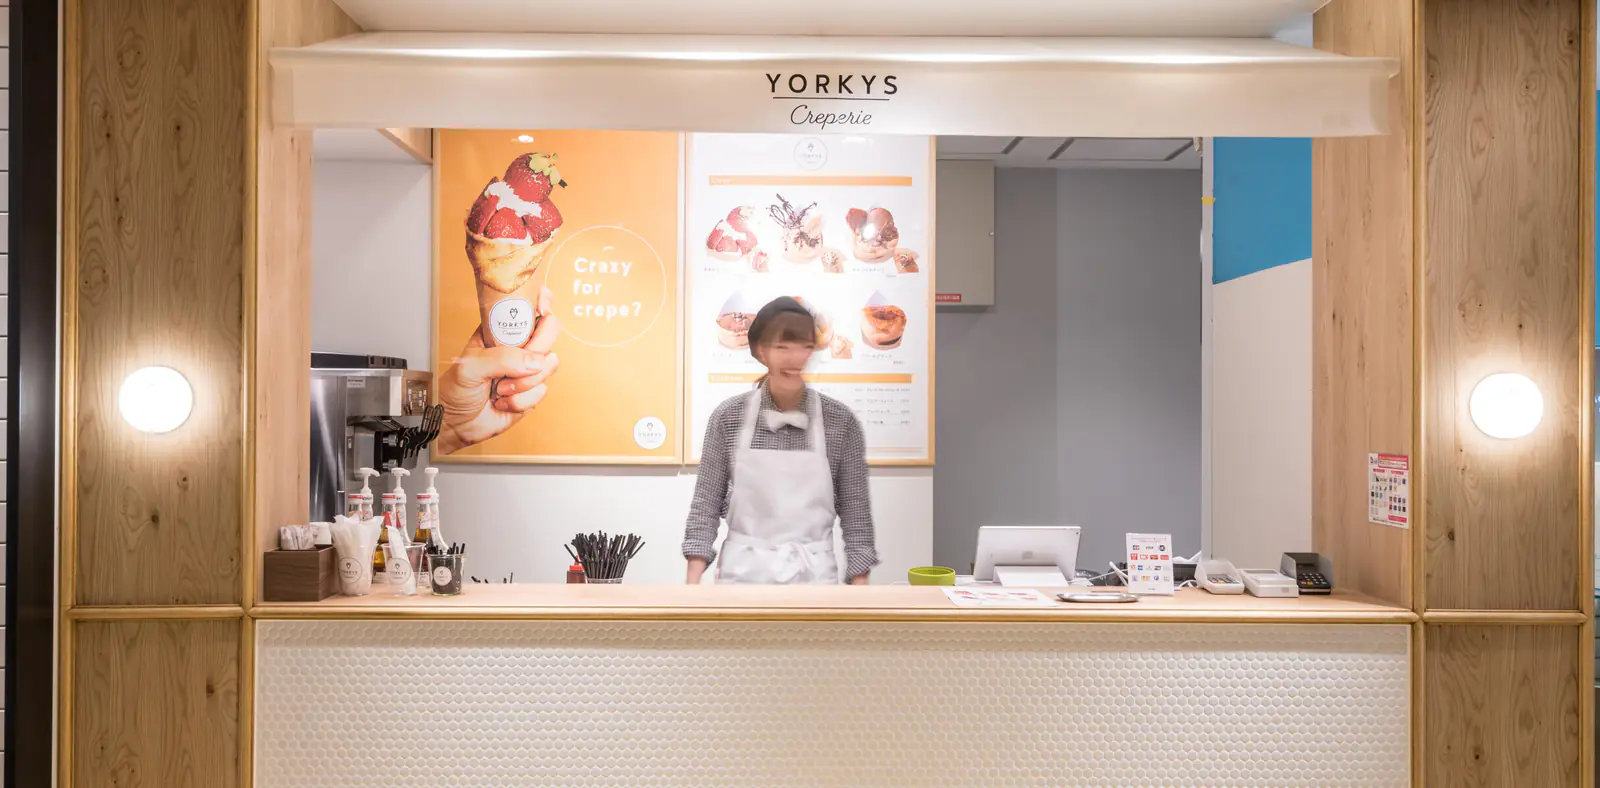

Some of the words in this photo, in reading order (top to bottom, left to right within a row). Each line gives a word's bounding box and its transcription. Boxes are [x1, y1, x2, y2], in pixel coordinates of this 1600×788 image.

[766, 73, 898, 95] YORKYS
[790, 104, 872, 129] Creperie
[574, 256, 632, 277] Crazy
[573, 278, 602, 295] for
[573, 301, 642, 321] crepe?
[497, 320, 528, 328] YORKYS
